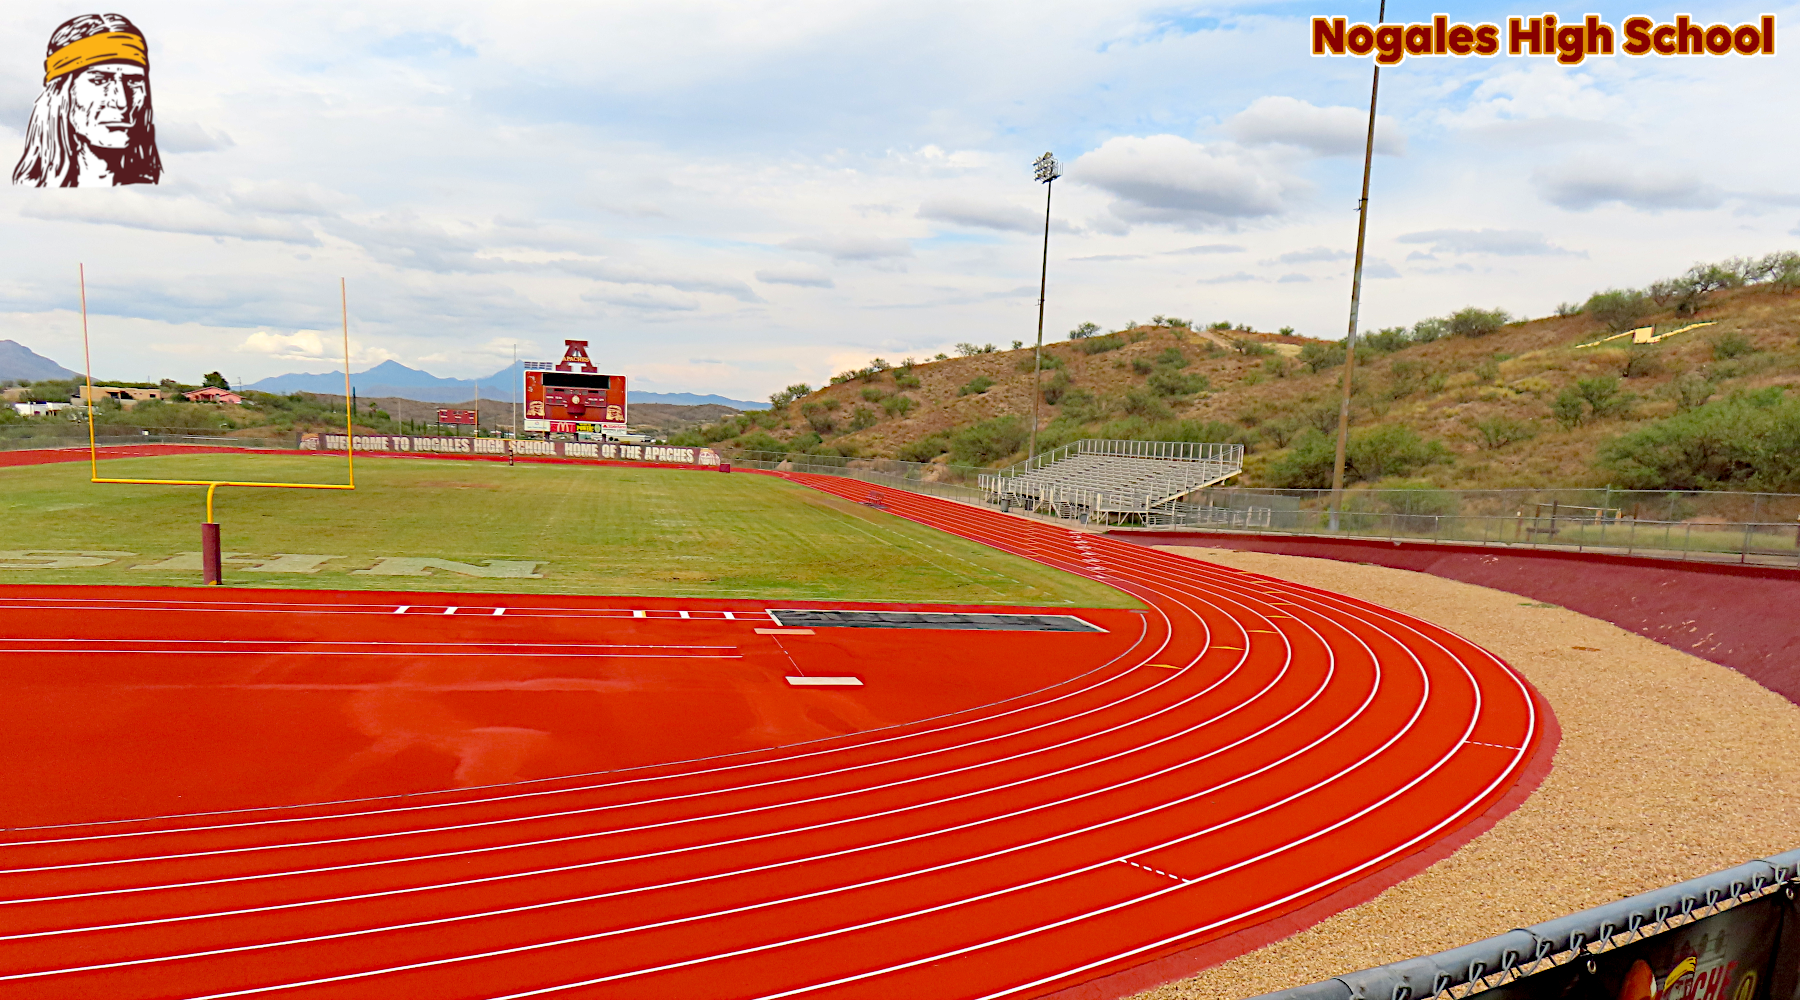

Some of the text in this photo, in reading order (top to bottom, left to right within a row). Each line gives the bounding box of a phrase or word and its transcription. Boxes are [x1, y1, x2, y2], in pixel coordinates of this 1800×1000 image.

[326, 434, 694, 464] WECOME TO NOGALES HIGH SCHOOL HOME OF THE APACHES
